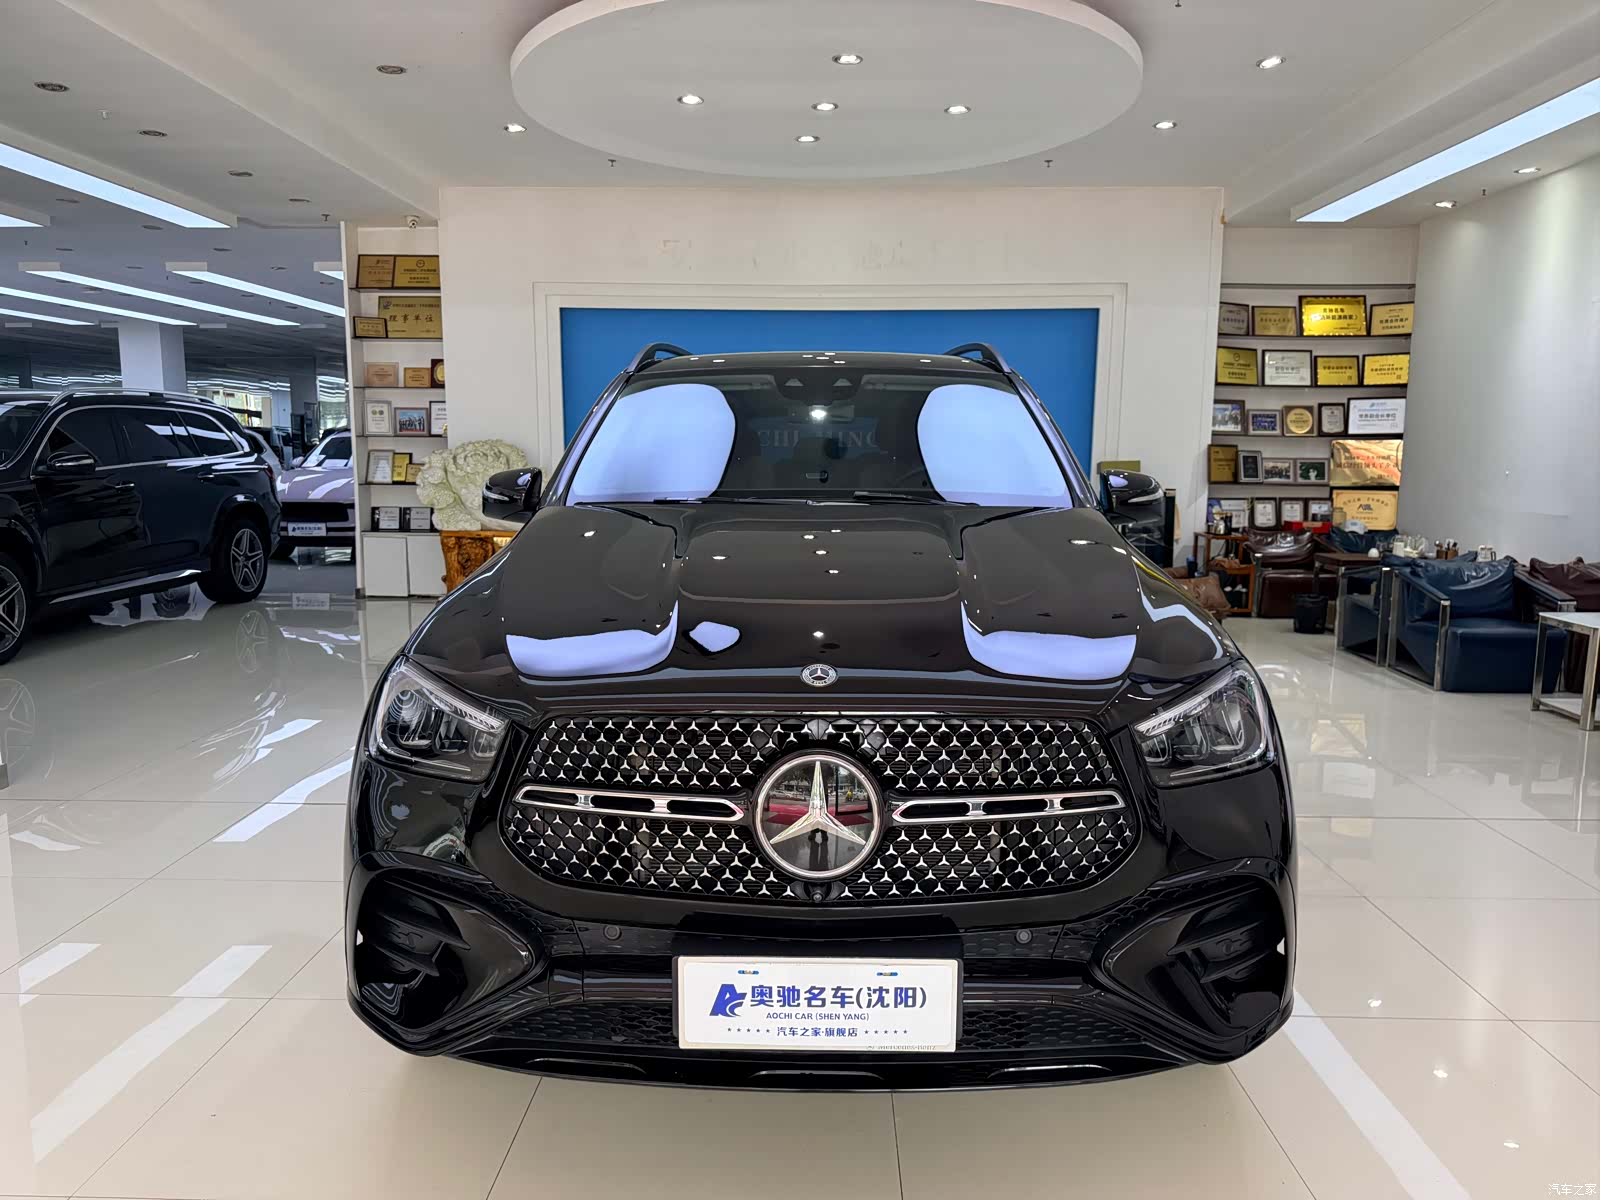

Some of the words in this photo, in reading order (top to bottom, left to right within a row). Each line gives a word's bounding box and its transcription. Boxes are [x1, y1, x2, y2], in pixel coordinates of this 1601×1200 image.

[750, 984, 928, 1009] 奥驰名车(沈阳)
[766, 1012, 793, 1020] AOCHI
[795, 1012, 813, 1020] CAR
[815, 1012, 841, 1021] (SHEN
[842, 1013, 870, 1021] YANG)
